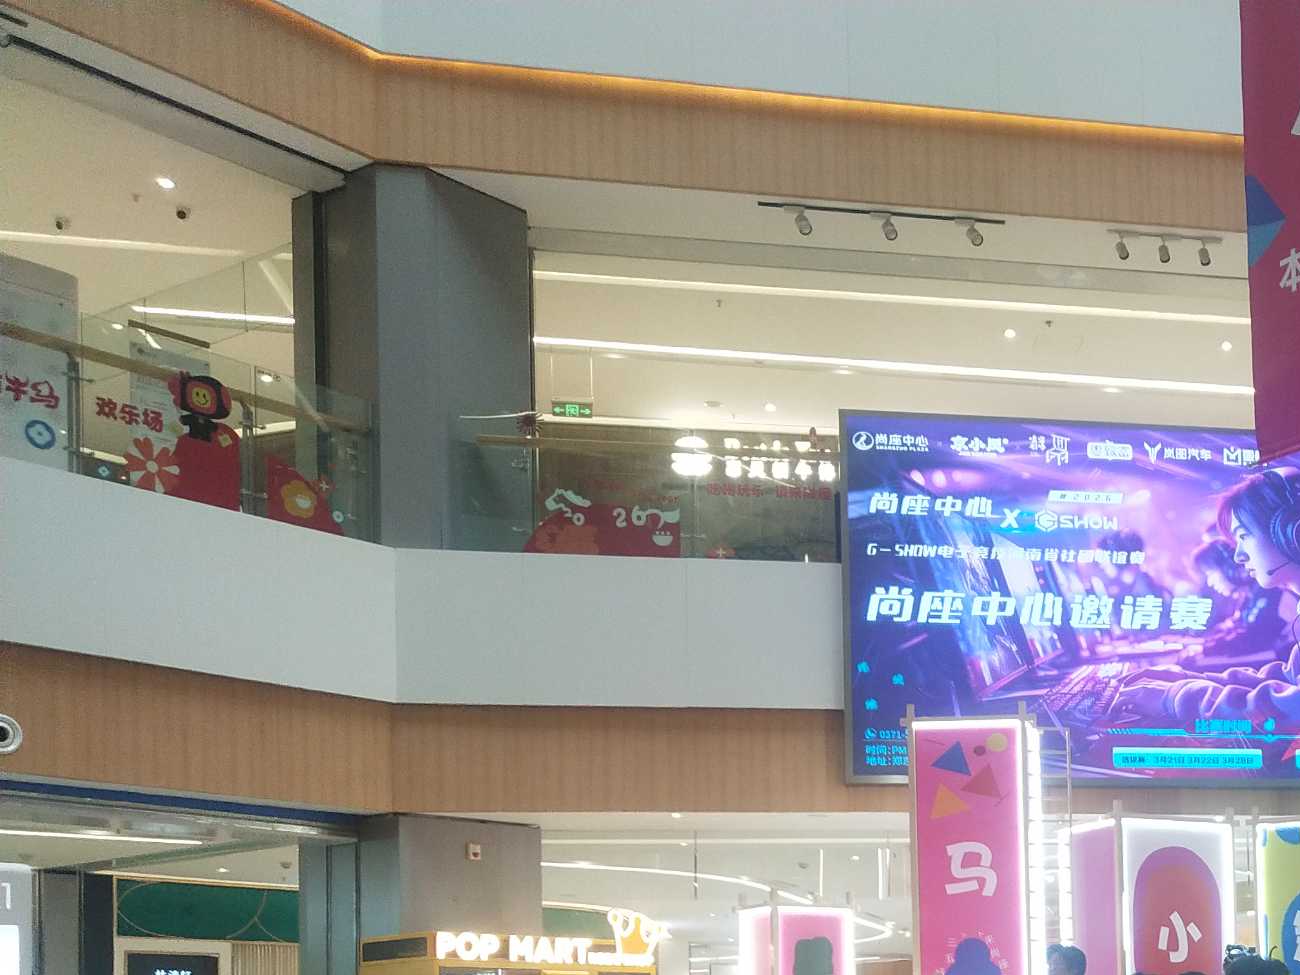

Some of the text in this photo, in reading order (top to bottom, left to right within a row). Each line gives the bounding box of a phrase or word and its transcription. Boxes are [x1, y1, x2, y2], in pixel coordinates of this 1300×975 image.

[96, 396, 164, 433] 欢乐场
[875, 433, 928, 449] 尚座中心
[869, 492, 1001, 518] 尚座中心
[867, 586, 1213, 630] 尚座中心邀请赛
[435, 931, 500, 961] POP
[508, 934, 593, 964] MART
[1158, 911, 1202, 963] 小
